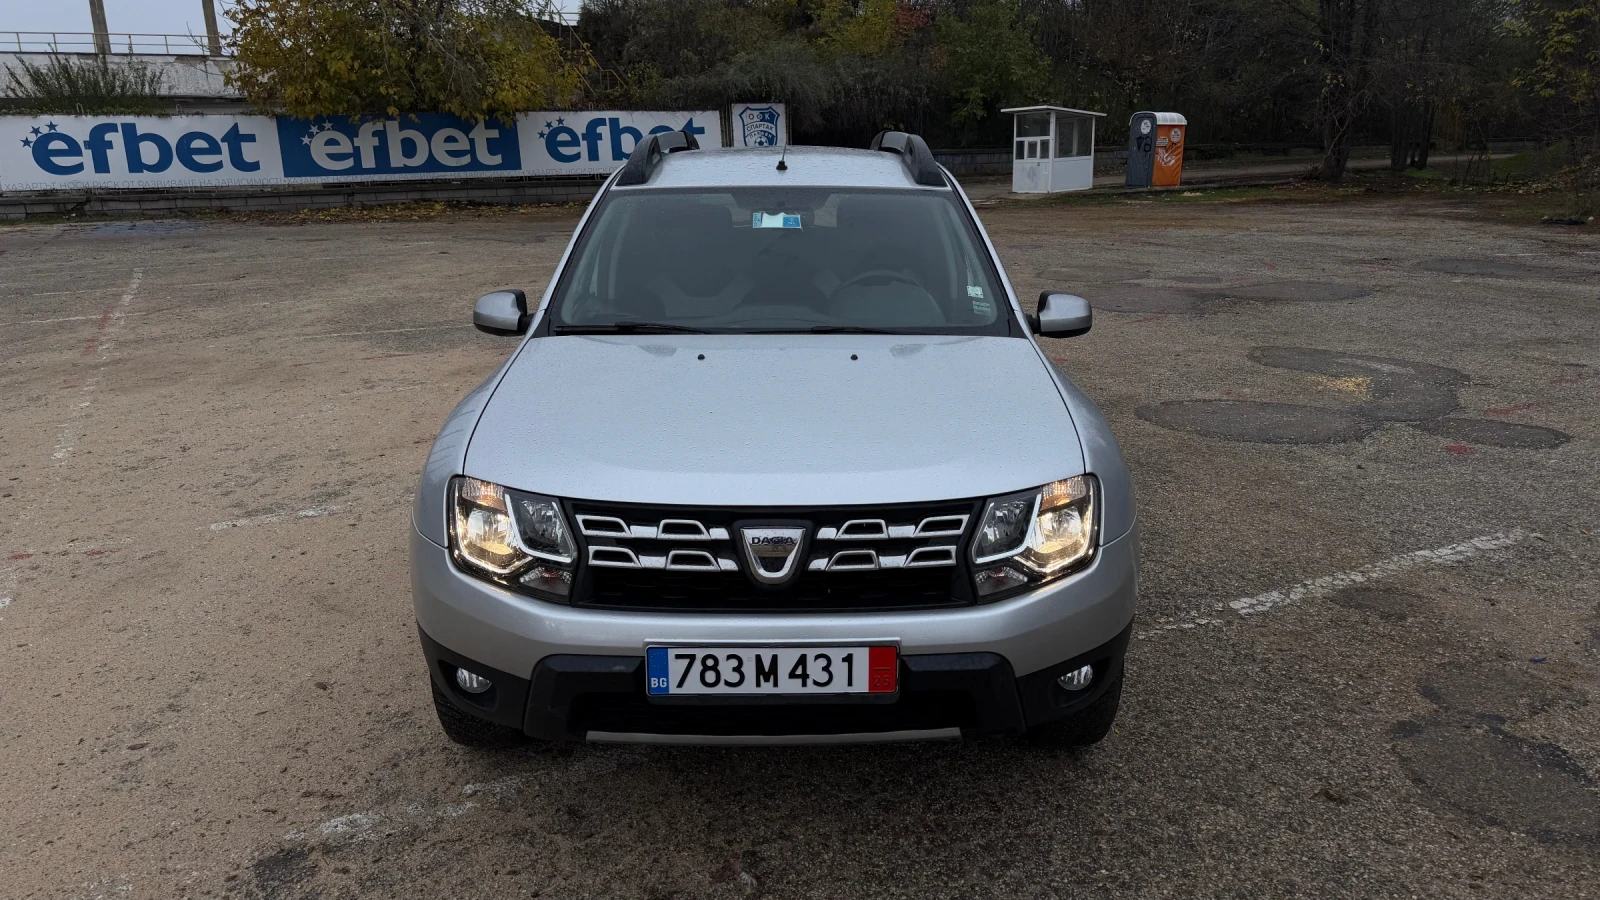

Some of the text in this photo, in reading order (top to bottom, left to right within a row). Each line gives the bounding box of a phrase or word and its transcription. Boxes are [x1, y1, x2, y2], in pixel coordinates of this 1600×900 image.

[32, 122, 260, 175] efbet
[310, 120, 503, 171] efbet
[545, 117, 705, 163] efb
[4, 181, 57, 191] ХАЗАРТЪТ
[59, 181, 90, 190] НОСИ
[92, 180, 119, 189] РИСК
[122, 180, 135, 188] ОТ
[199, 178, 213, 187] НА
[752, 536, 795, 545] DACIA
[651, 677, 668, 688] BG
[674, 653, 854, 689] 783 M 431
[873, 675, 890, 687] 25
